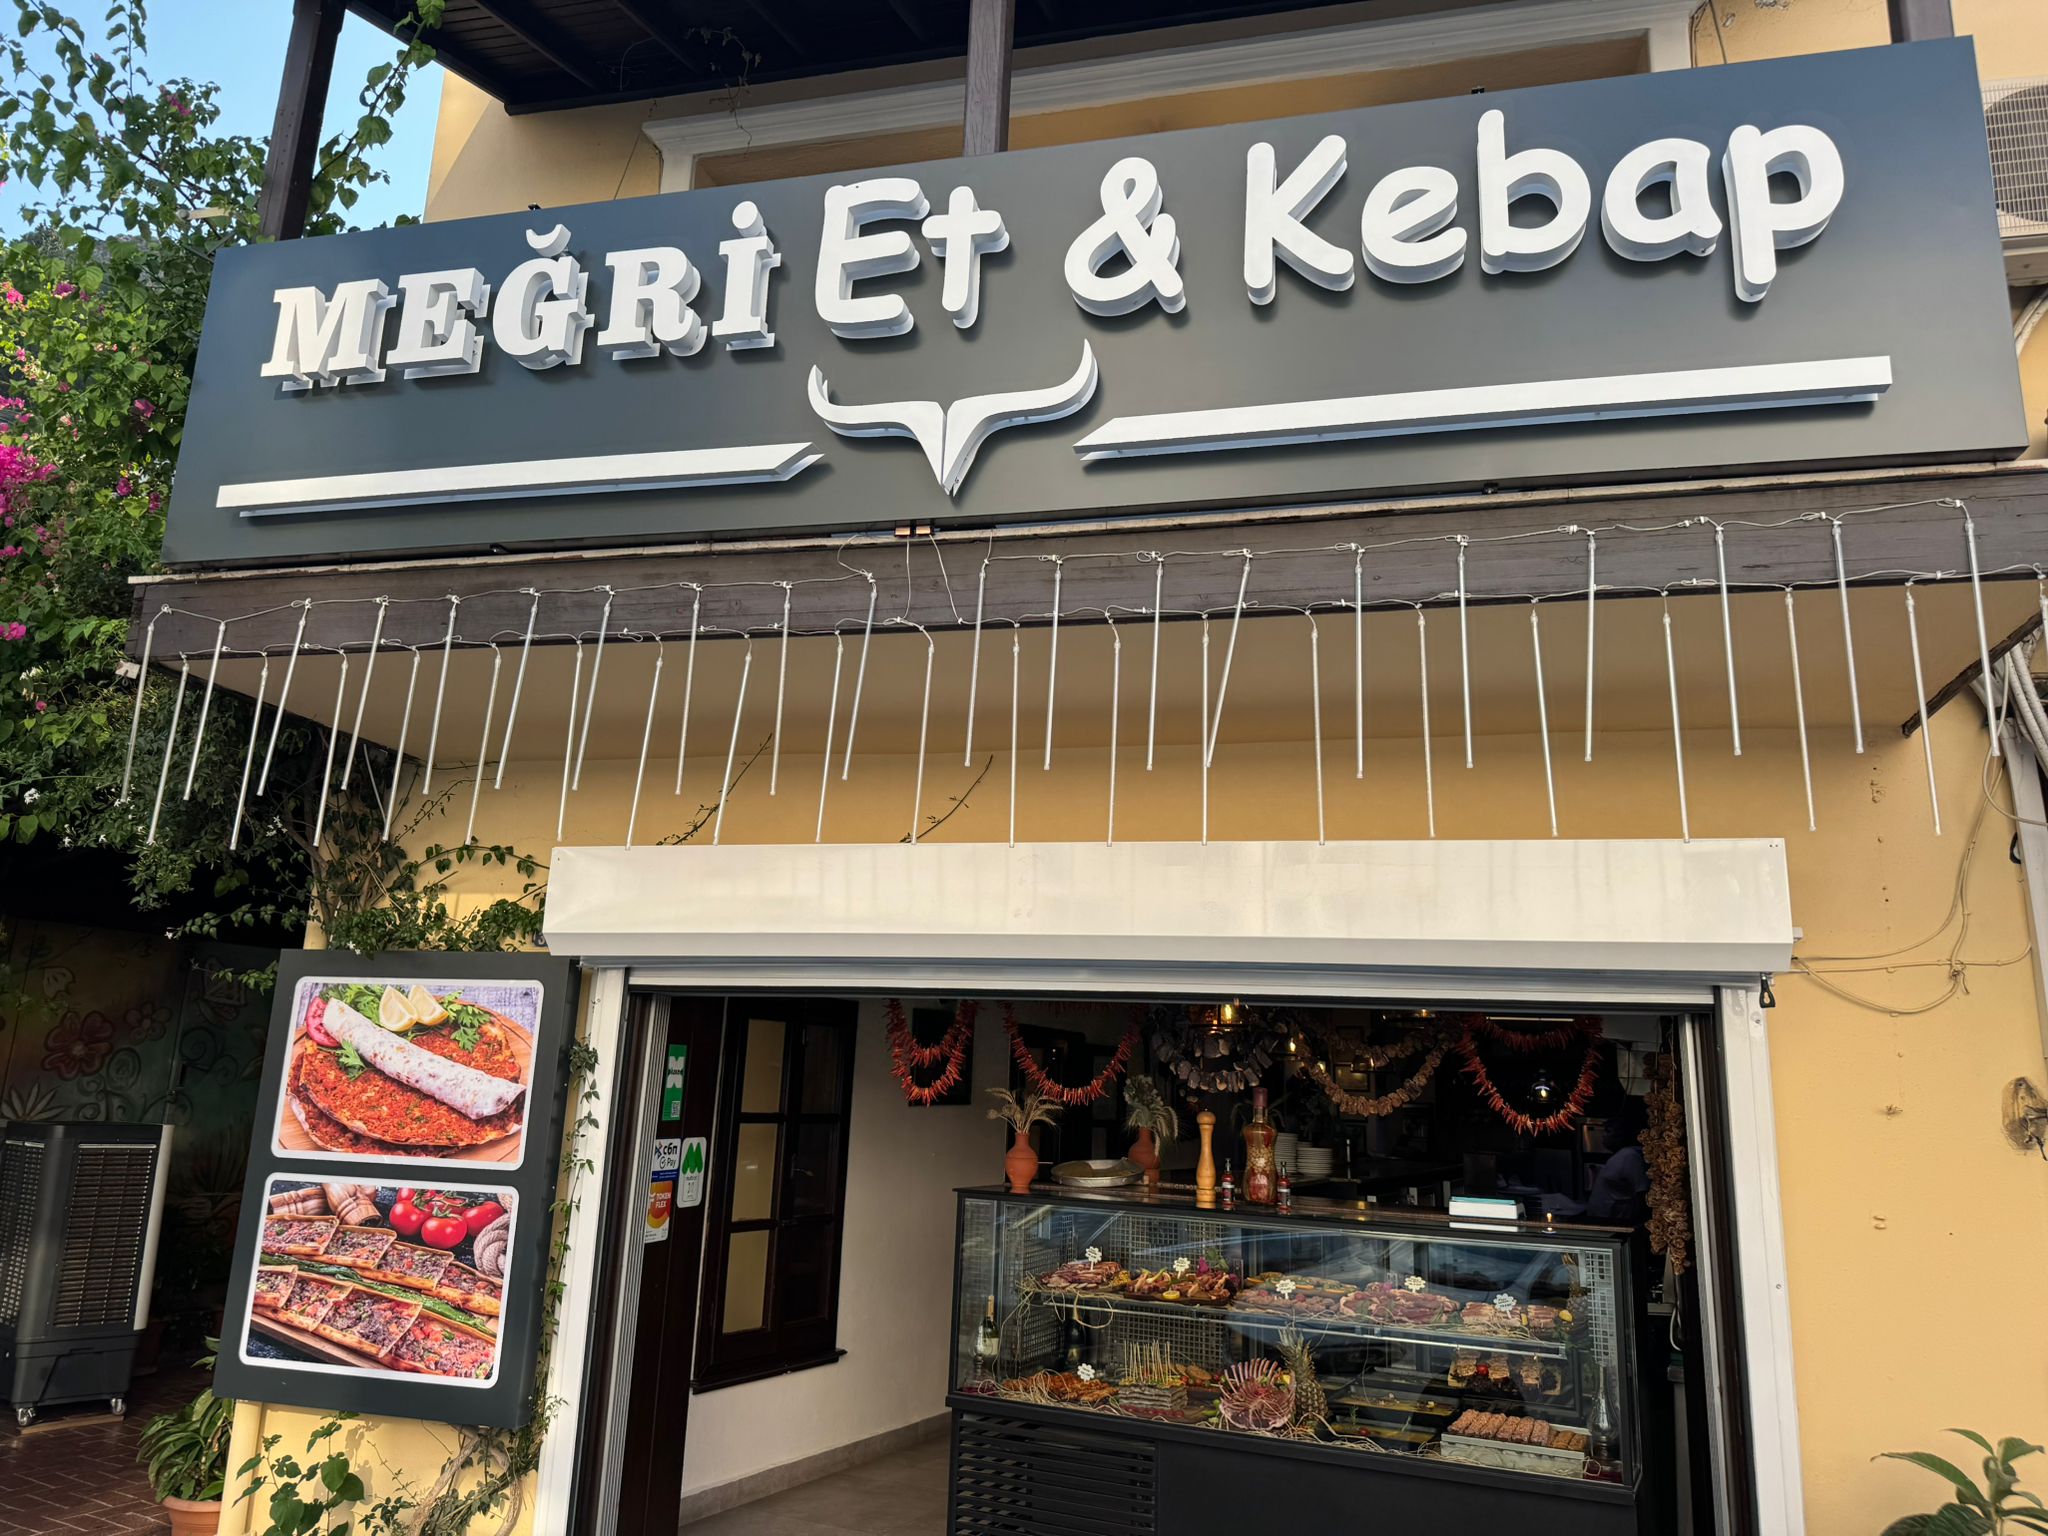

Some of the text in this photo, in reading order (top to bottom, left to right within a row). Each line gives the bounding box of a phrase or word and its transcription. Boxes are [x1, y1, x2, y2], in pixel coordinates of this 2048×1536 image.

[260, 109, 1844, 388] MEĞRİ Et & Kebap
